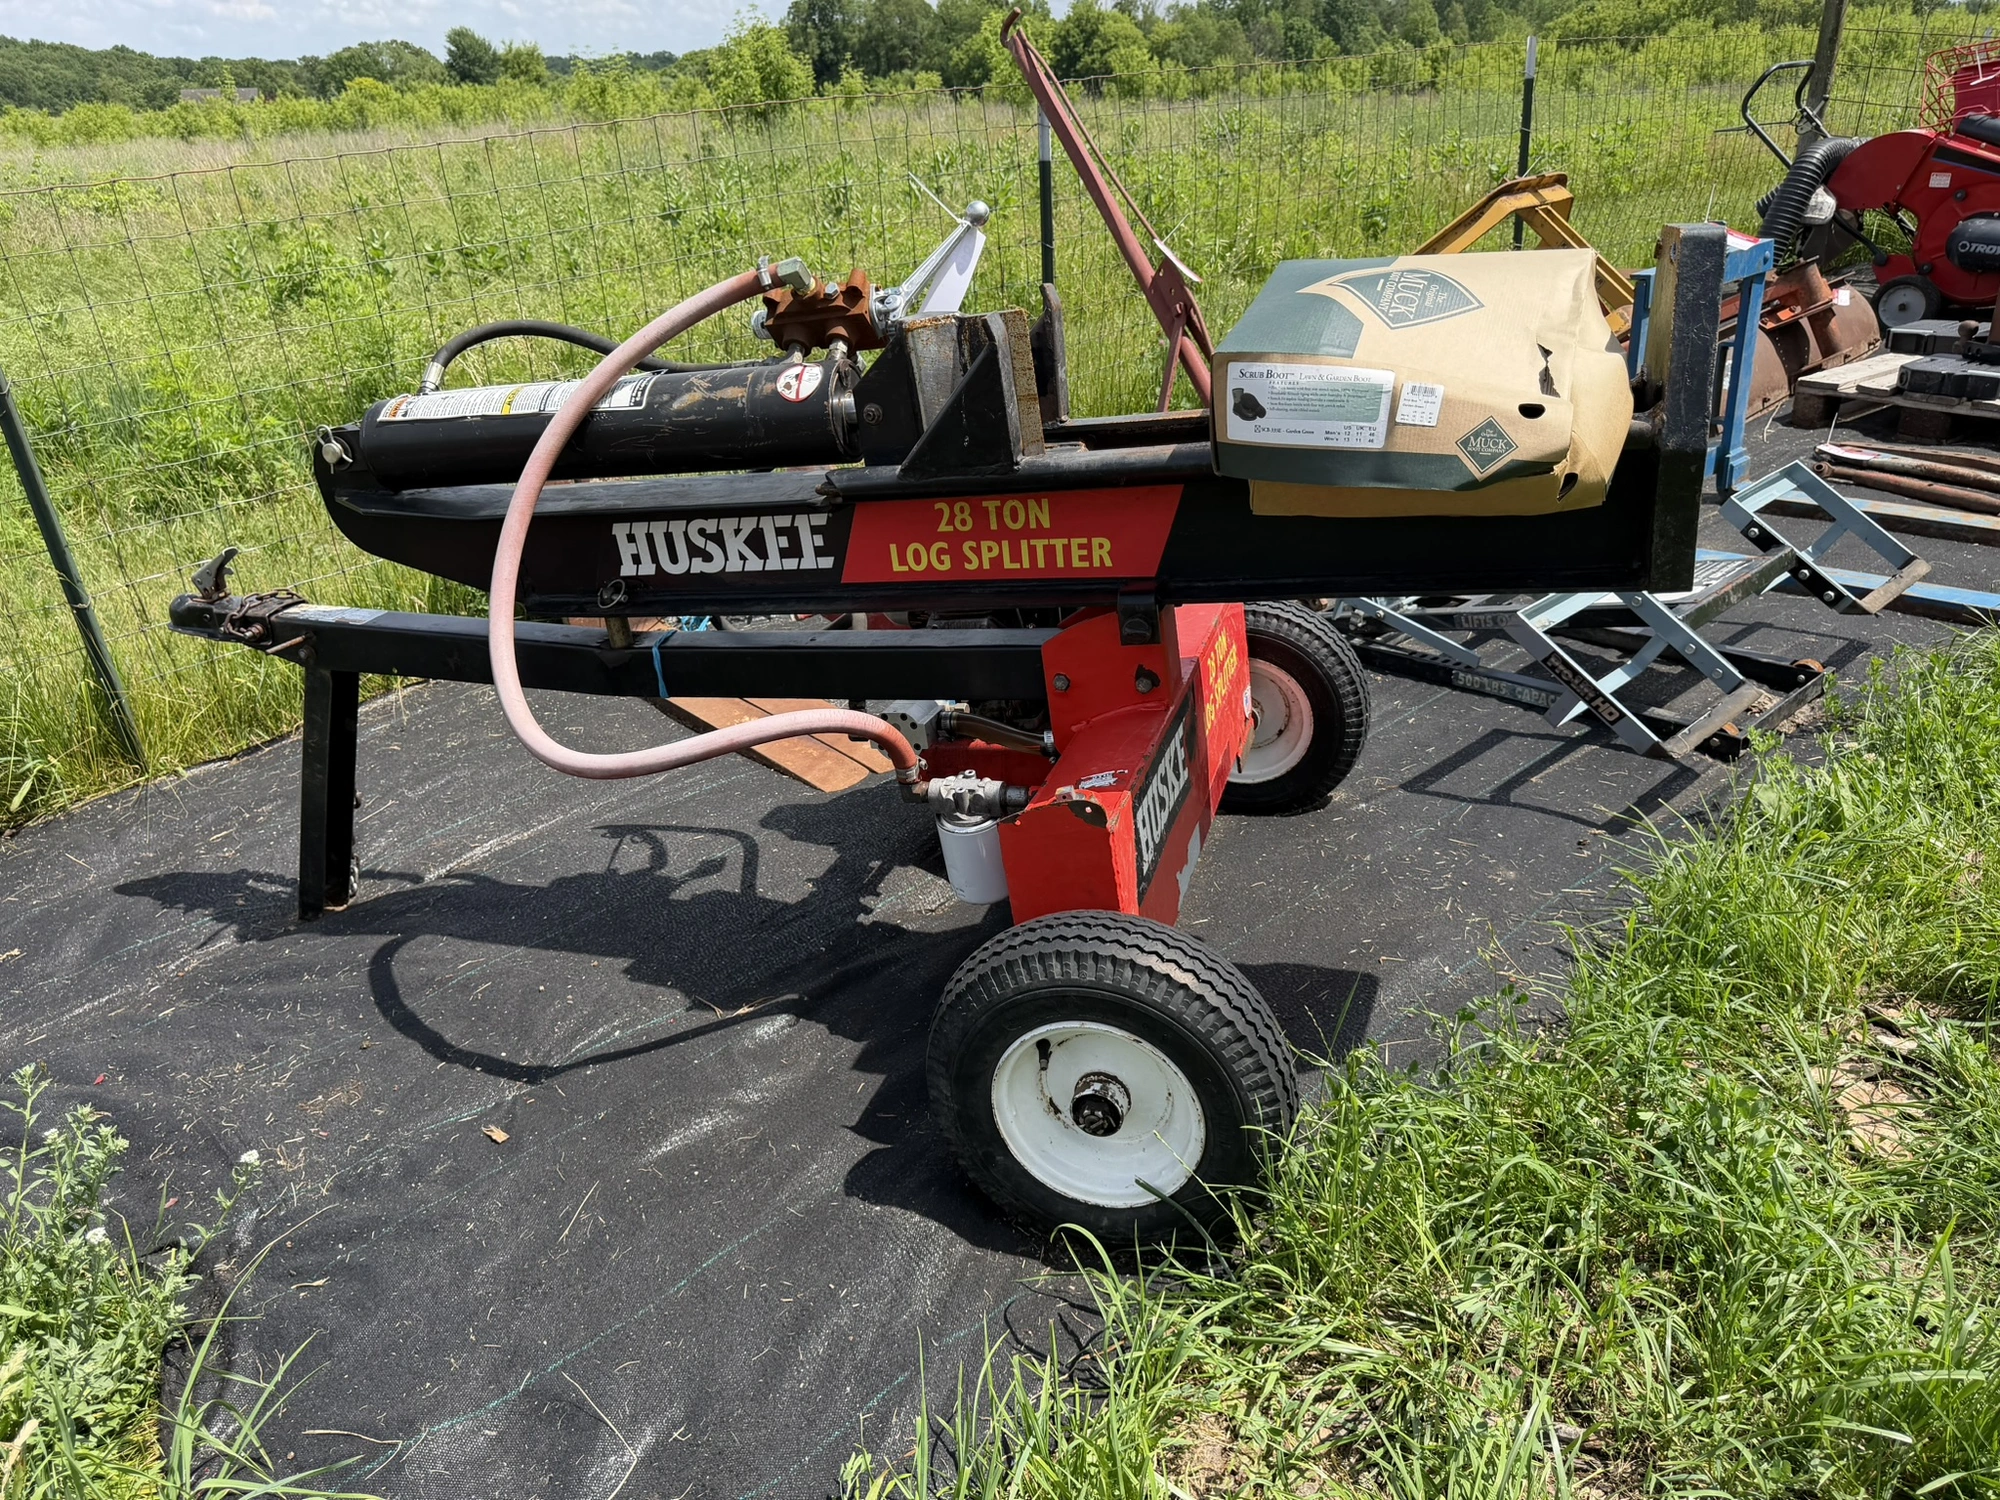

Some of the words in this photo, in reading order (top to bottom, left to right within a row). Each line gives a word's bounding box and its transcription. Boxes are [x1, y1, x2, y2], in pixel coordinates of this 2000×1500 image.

[1378, 281, 1398, 312] COMPANY
[1390, 271, 1432, 320] MUCK
[1425, 284, 1440, 309] Original
[1435, 291, 1448, 303] The
[1238, 368, 1265, 379] SCRUB
[1318, 373, 1325, 381] &
[1326, 373, 1352, 382] GARDEN
[1353, 375, 1372, 383] BOOT
[1468, 436, 1507, 450] MUCK
[934, 501, 973, 532] 28
[982, 498, 1051, 531] TON
[612, 513, 835, 577] HUSKEE
[889, 541, 952, 572] LOG
[962, 537, 1113, 570] SPLITTER
[1460, 613, 1494, 628] LIFTS
[1457, 671, 1482, 688] 500
[1515, 687, 1560, 708] CAPAC
[1590, 698, 1621, 722] HD
[1136, 717, 1190, 876] HUSKE
